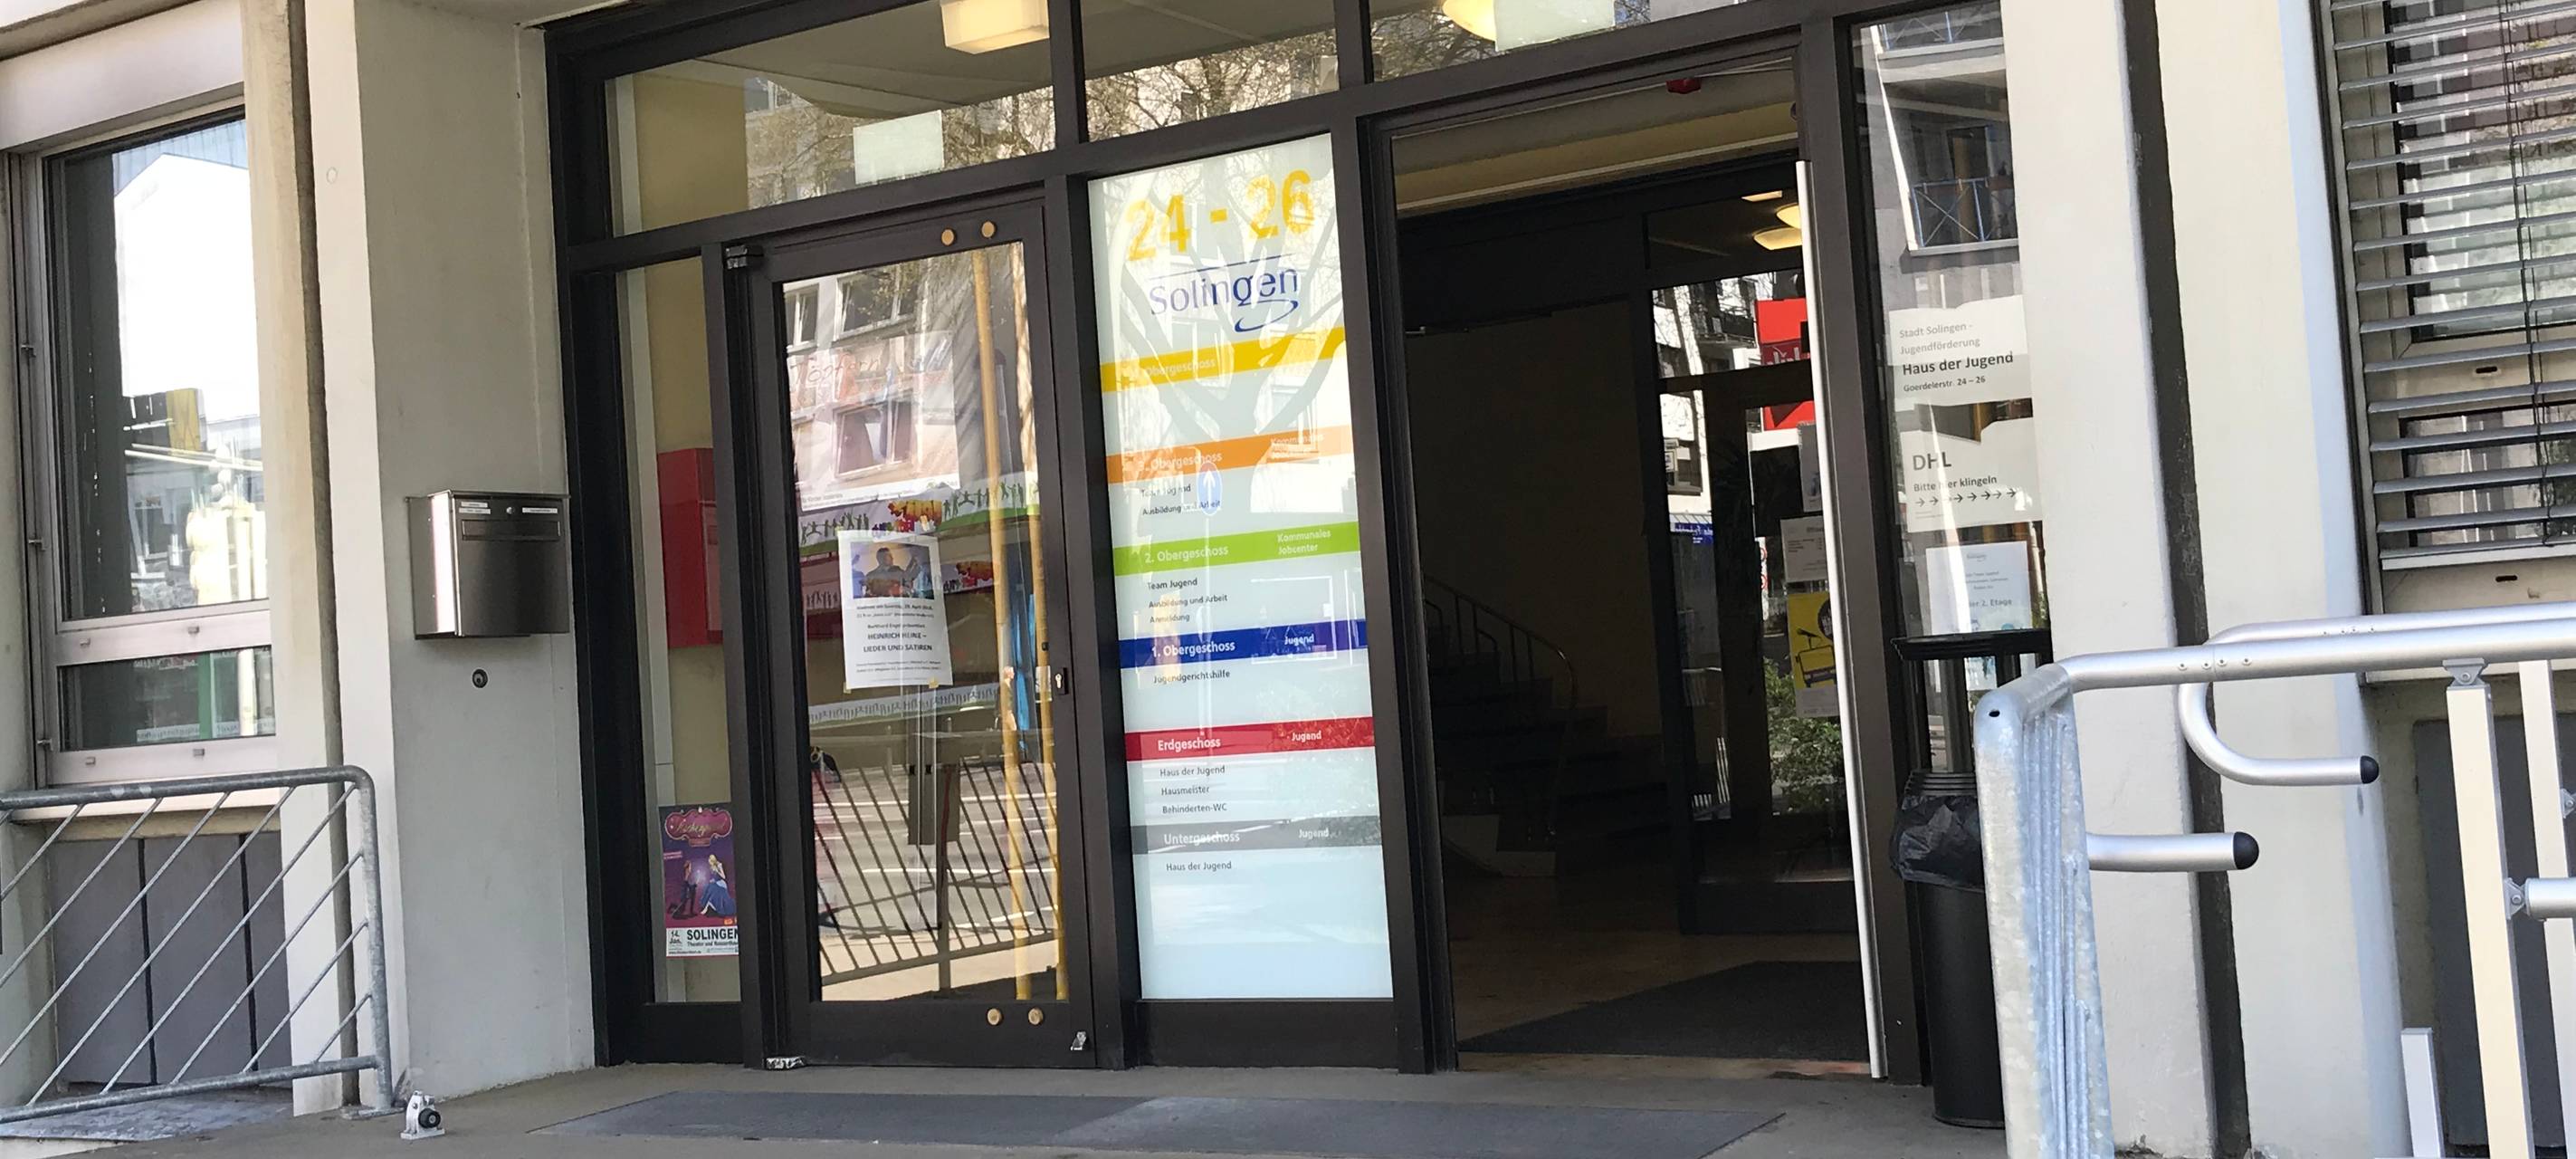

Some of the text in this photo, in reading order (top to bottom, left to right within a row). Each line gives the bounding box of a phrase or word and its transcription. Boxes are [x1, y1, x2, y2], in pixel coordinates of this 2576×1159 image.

[1126, 169, 1314, 261] 24 - 26
[1150, 267, 1298, 315] Solingen
[1900, 327, 1924, 339] Stadt
[1926, 322, 1967, 336] Solingen
[1900, 338, 1980, 355] Jugendförderung
[1903, 350, 2014, 376] Haus der Jugend
[1957, 377, 1967, 387] 24
[1976, 375, 1986, 385] 26
[1150, 453, 1223, 471] Obergeschoss
[1913, 481, 1936, 492] Bitte
[1960, 475, 1998, 490] klingeln
[1142, 504, 1182, 516] Ausbildung
[1277, 530, 1331, 543] Kommunales
[1145, 546, 1228, 564] 2. Obergeschoss
[1278, 543, 1318, 556] Jobcenter
[1148, 577, 1197, 590] Team Jugend
[1149, 594, 1227, 608] Ausbildung und Arbeit
[1284, 633, 1315, 647] Jugend
[863, 645, 886, 653] LIEDER
[1151, 640, 1236, 658] 1. Obergeschoss
[1154, 669, 1230, 684] Jugendgerichtshilfe
[1292, 730, 1321, 742] Jugend
[1158, 736, 1221, 753] Erdgeschoss
[1159, 765, 1226, 778] Haus der Jugend
[1161, 785, 1210, 797] Hausmeister
[1162, 802, 1227, 815] Behinderten-WC
[1164, 831, 1240, 848] Untergeschoss
[1299, 827, 1329, 840] Jugend
[1167, 860, 1232, 874] Haus der Jugend
